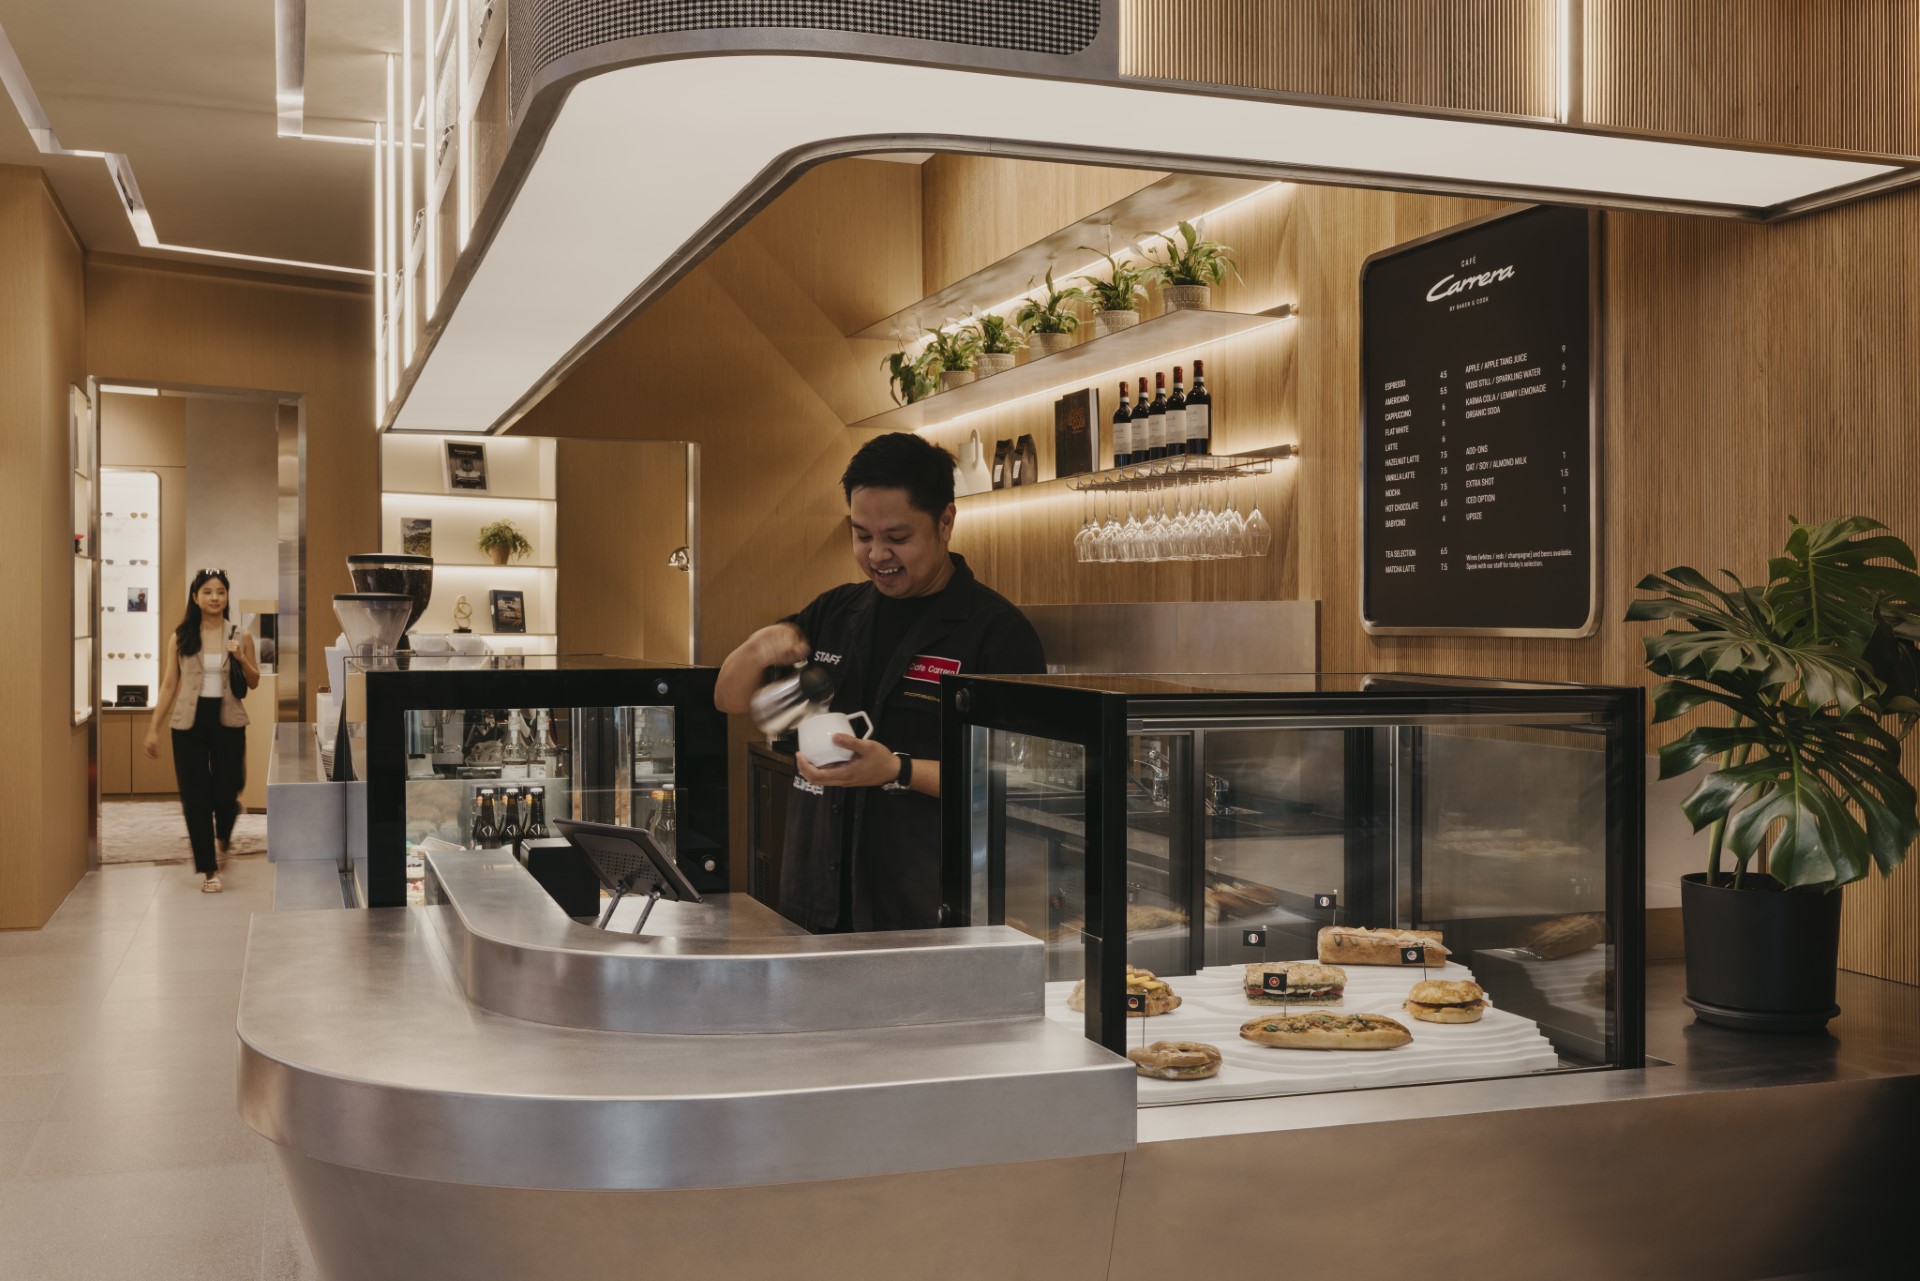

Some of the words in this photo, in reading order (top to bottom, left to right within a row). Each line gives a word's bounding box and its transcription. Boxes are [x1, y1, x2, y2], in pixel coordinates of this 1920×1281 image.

[1426, 264, 1516, 302] Carrera
[1456, 301, 1470, 310] BAKER
[1476, 296, 1489, 305] COOK
[1465, 364, 1480, 374] APPLE
[1484, 360, 1499, 370] APPLE
[1500, 356, 1512, 366] TANG
[1514, 352, 1528, 364] JUICE
[1562, 344, 1566, 352] 9
[1466, 380, 1478, 390] VOSS
[1478, 378, 1492, 387] STILL
[1496, 370, 1523, 384] SPARKLING
[1523, 367, 1541, 379] WATER
[1384, 379, 1406, 390] ESPRESSO
[1466, 396, 1482, 406] KARMA
[1482, 394, 1496, 404] COLA
[1518, 384, 1547, 397] LEMONADE
[1562, 380, 1566, 388] 7
[1384, 394, 1410, 406] AMERICANO
[1384, 409, 1412, 422] CAPPUCCINO
[1466, 408, 1487, 419] ORGANIC
[1487, 406, 1500, 416] SODA
[1384, 427, 1395, 436] FLAT
[1396, 424, 1410, 434] WHITE
[1384, 442, 1398, 452] LATTE
[1466, 444, 1488, 455] ADD-ONS
[1385, 456, 1406, 467] HAZELNUT
[1407, 454, 1420, 464] LATTE
[1466, 462, 1475, 472] OAT
[1479, 461, 1489, 470] SOY
[1493, 457, 1514, 468] ALMOND
[1514, 456, 1528, 465] MILK
[1385, 472, 1402, 482] VANILLA
[1402, 470, 1416, 480] LATTE
[1466, 479, 1481, 488] EXTRA
[1481, 477, 1494, 487] SHOT
[1385, 488, 1401, 497] MOCHA
[1466, 496, 1477, 504] ICED
[1477, 494, 1496, 503] OPTION
[1385, 504, 1394, 512] HOT
[1394, 501, 1419, 511] CHOCOLATE
[1466, 512, 1482, 521] UPSIZE
[1385, 518, 1406, 528] BABYCINO
[1394, 549, 1416, 558] SELECTION
[1385, 565, 1402, 574] MATCHA
[1402, 564, 1416, 573] LATTE
[1466, 563, 1477, 571] Speak
[908, 662, 926, 672] Cafe
